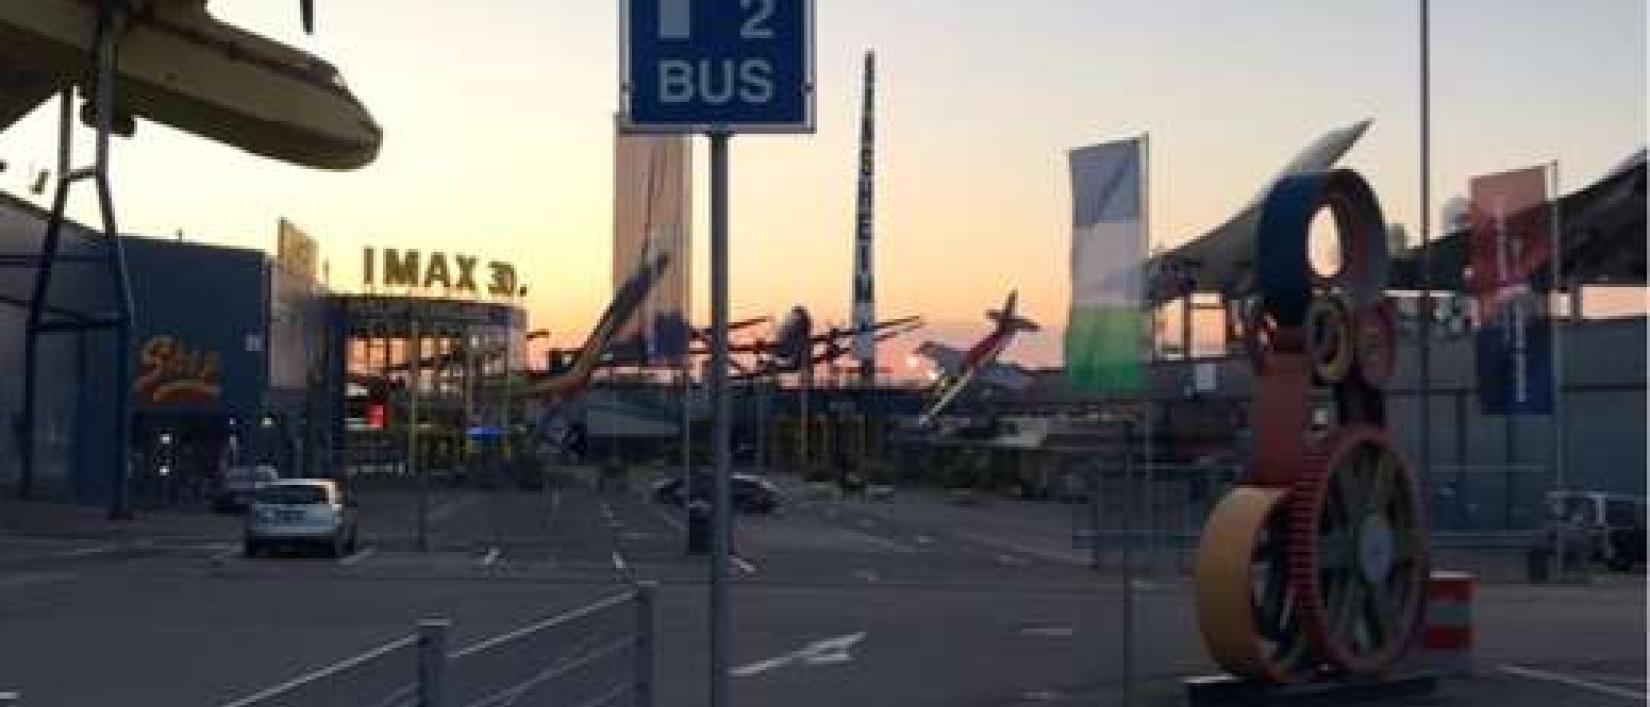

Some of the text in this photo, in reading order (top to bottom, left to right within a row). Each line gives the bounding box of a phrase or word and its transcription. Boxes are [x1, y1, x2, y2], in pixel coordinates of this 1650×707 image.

[739, 0, 775, 38] 2
[658, 59, 773, 104] BUS
[363, 247, 478, 291] IMAX
